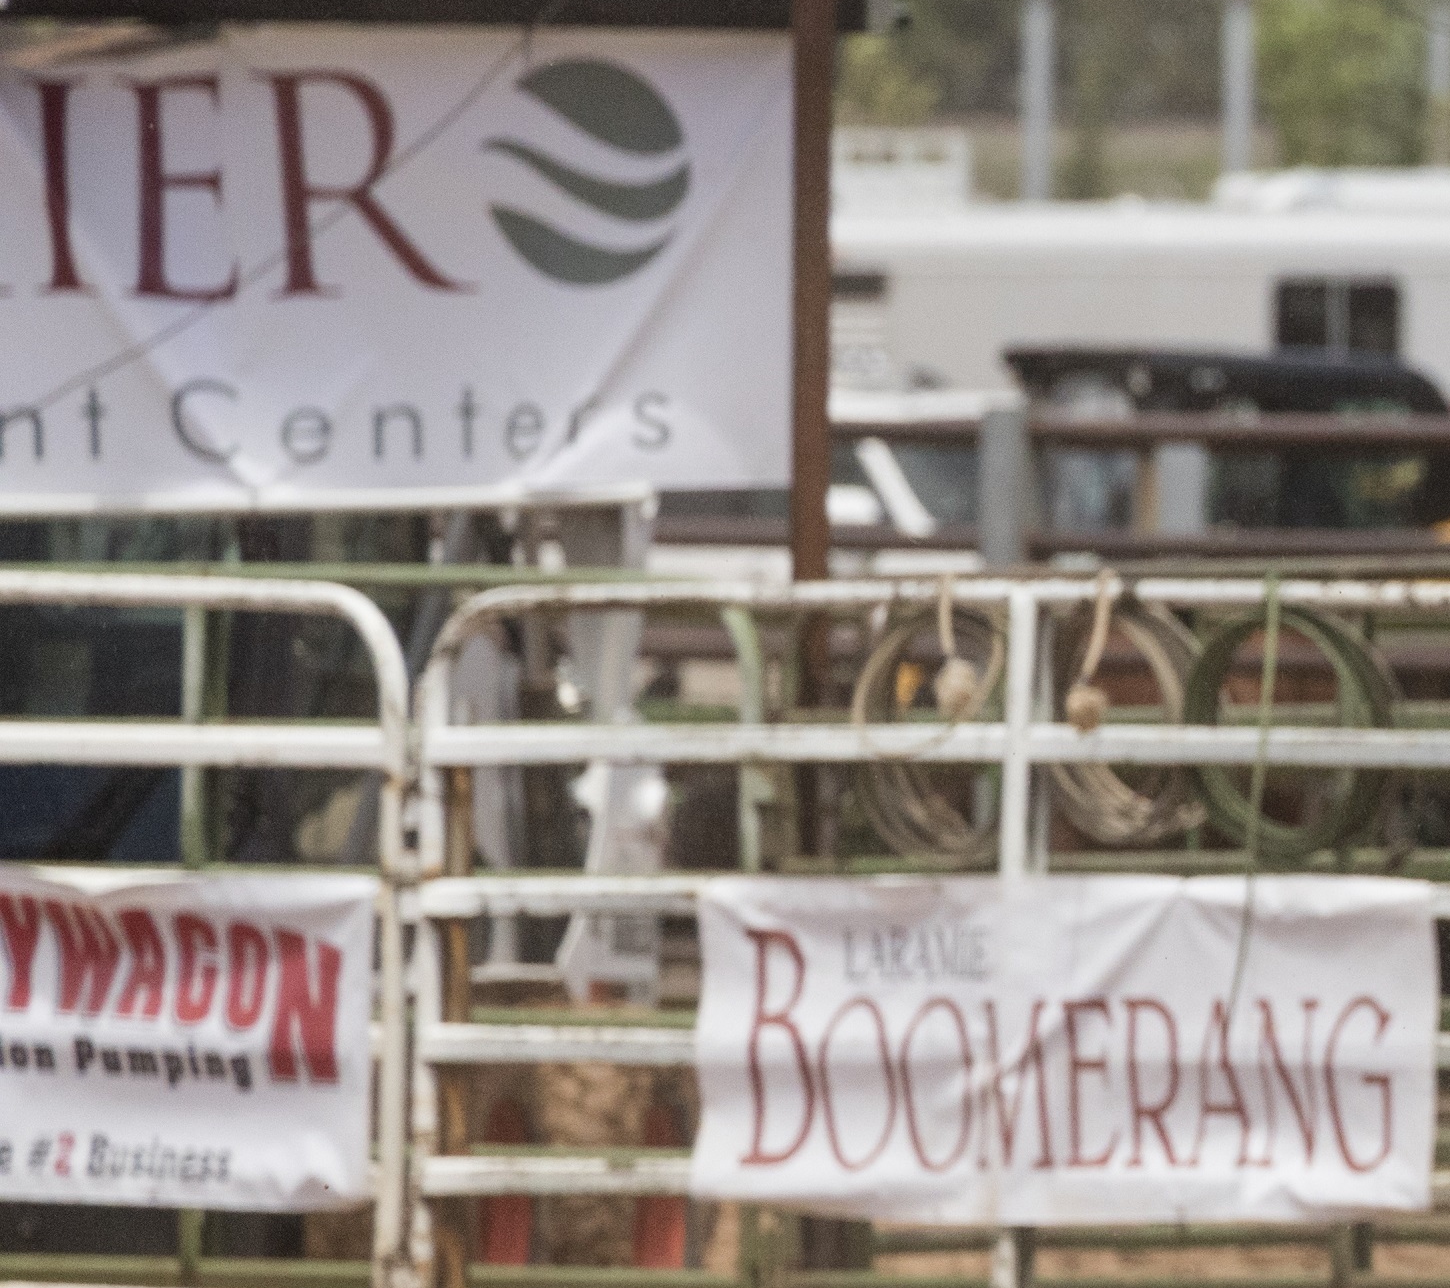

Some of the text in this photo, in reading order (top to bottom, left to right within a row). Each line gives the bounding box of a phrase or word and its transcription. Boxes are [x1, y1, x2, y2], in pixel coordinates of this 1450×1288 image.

[0, 68, 477, 301] IER
[169, 376, 674, 464] Centers
[74, 1035, 253, 1094] Pumping
[739, 928, 1394, 1175] BOOMERANG
